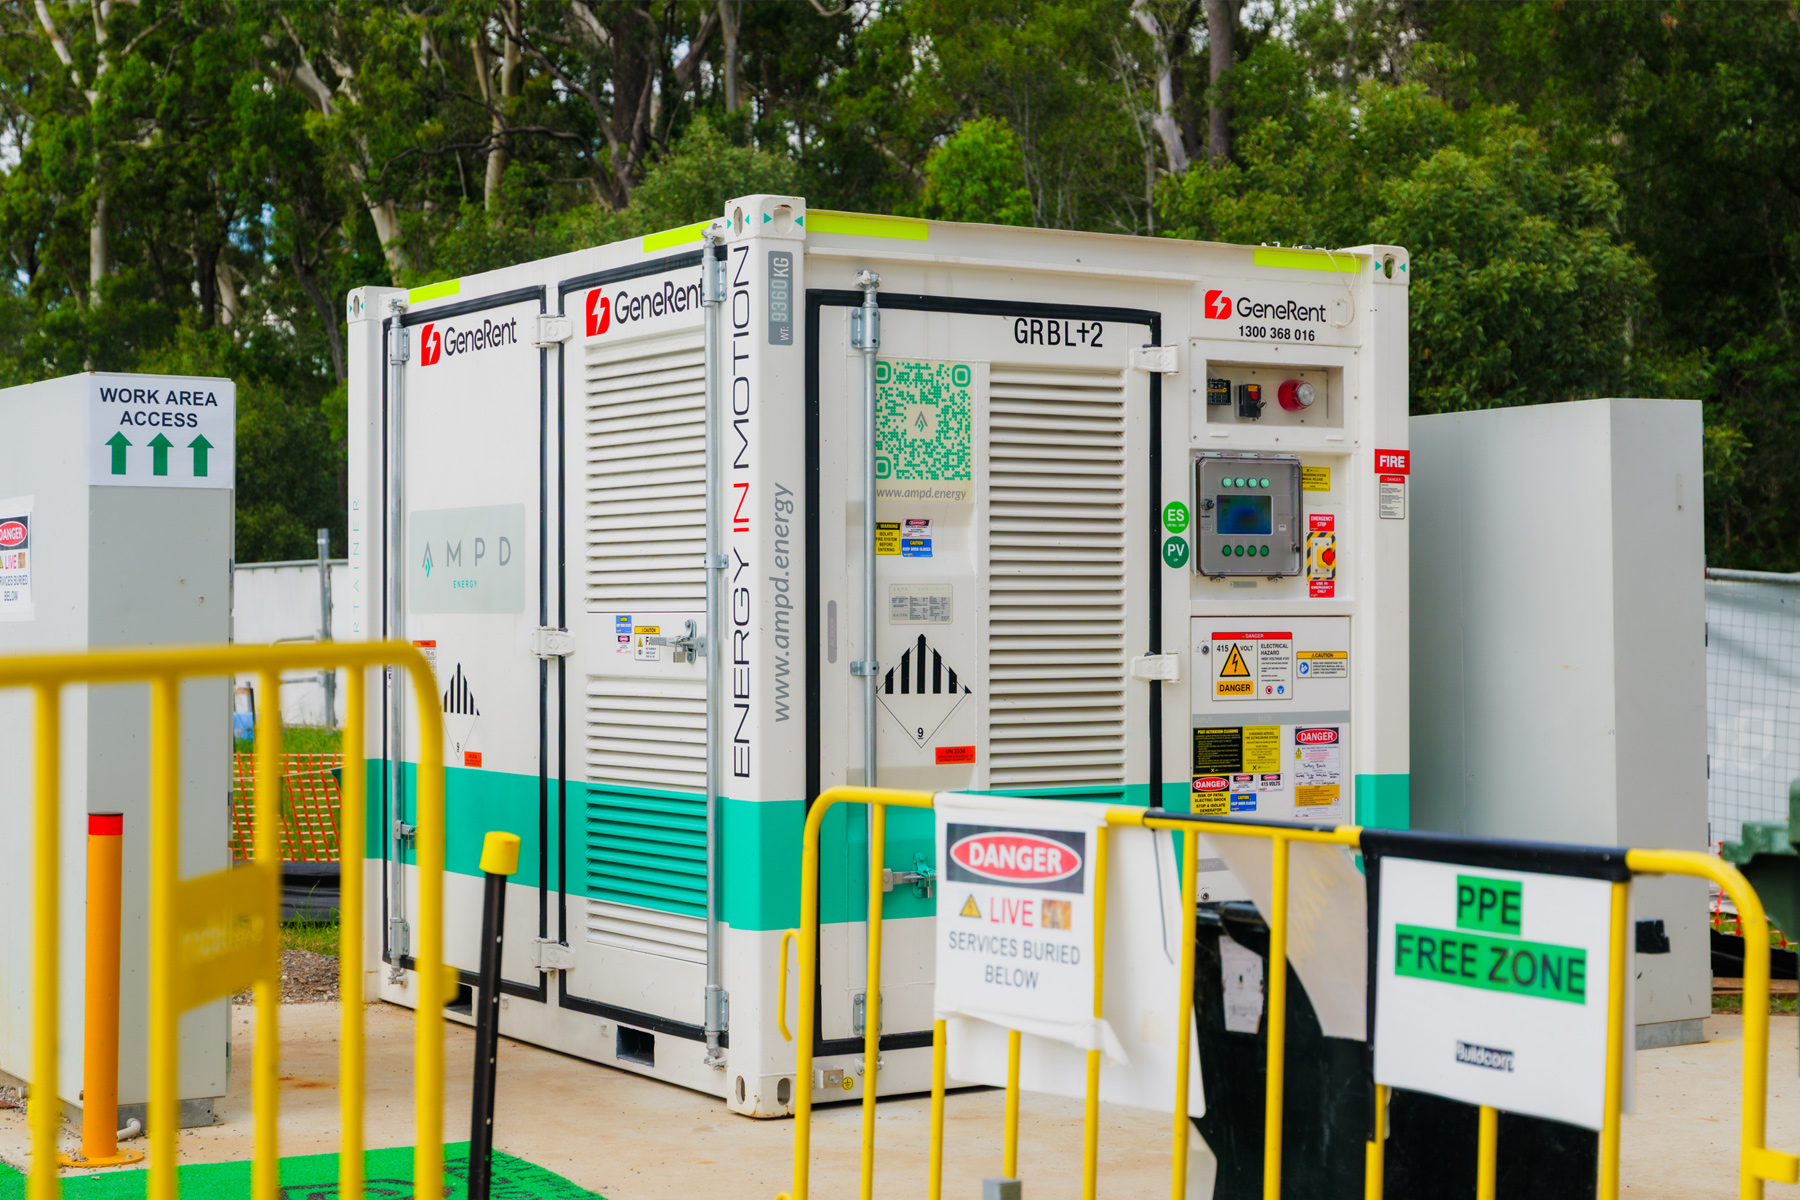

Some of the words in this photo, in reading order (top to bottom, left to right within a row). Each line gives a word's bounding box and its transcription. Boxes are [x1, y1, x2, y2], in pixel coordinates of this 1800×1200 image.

[614, 278, 703, 324] GeneRent
[1236, 297, 1326, 322] GeneRent
[444, 317, 517, 356] GeneRent
[780, 326, 789, 341] WT:
[1014, 317, 1103, 348] GRBL+2
[1238, 326, 1266, 338] 1300
[1270, 327, 1291, 340] 368
[1294, 329, 1315, 342] 016
[733, 245, 750, 469] MOTION
[100, 388, 160, 405] WORK
[165, 390, 218, 406] AREA
[120, 411, 198, 428] ACCESS
[1380, 455, 1405, 468] FIRE
[876, 488, 966, 500] www.ampd.energy
[733, 482, 750, 532] IN
[1168, 509, 1184, 522] ES
[5, 554, 16, 570] LIVE
[422, 536, 512, 578] AMPD
[1168, 544, 1184, 556] PV
[453, 580, 478, 588] ENERGY
[769, 482, 794, 722] www.ampd.energy
[733, 547, 750, 778] ENERGY
[918, 728, 924, 739] 9
[1301, 732, 1333, 741] DANGER
[969, 842, 1062, 874] DANGER
[990, 897, 1034, 927] LIVE
[1458, 885, 1521, 926] PPE
[949, 931, 1018, 958] SERVICES
[1023, 940, 1080, 965] BURIED
[985, 965, 1039, 989] BELOW
[1397, 934, 1477, 978] FREE
[1488, 946, 1585, 995] ZONE
